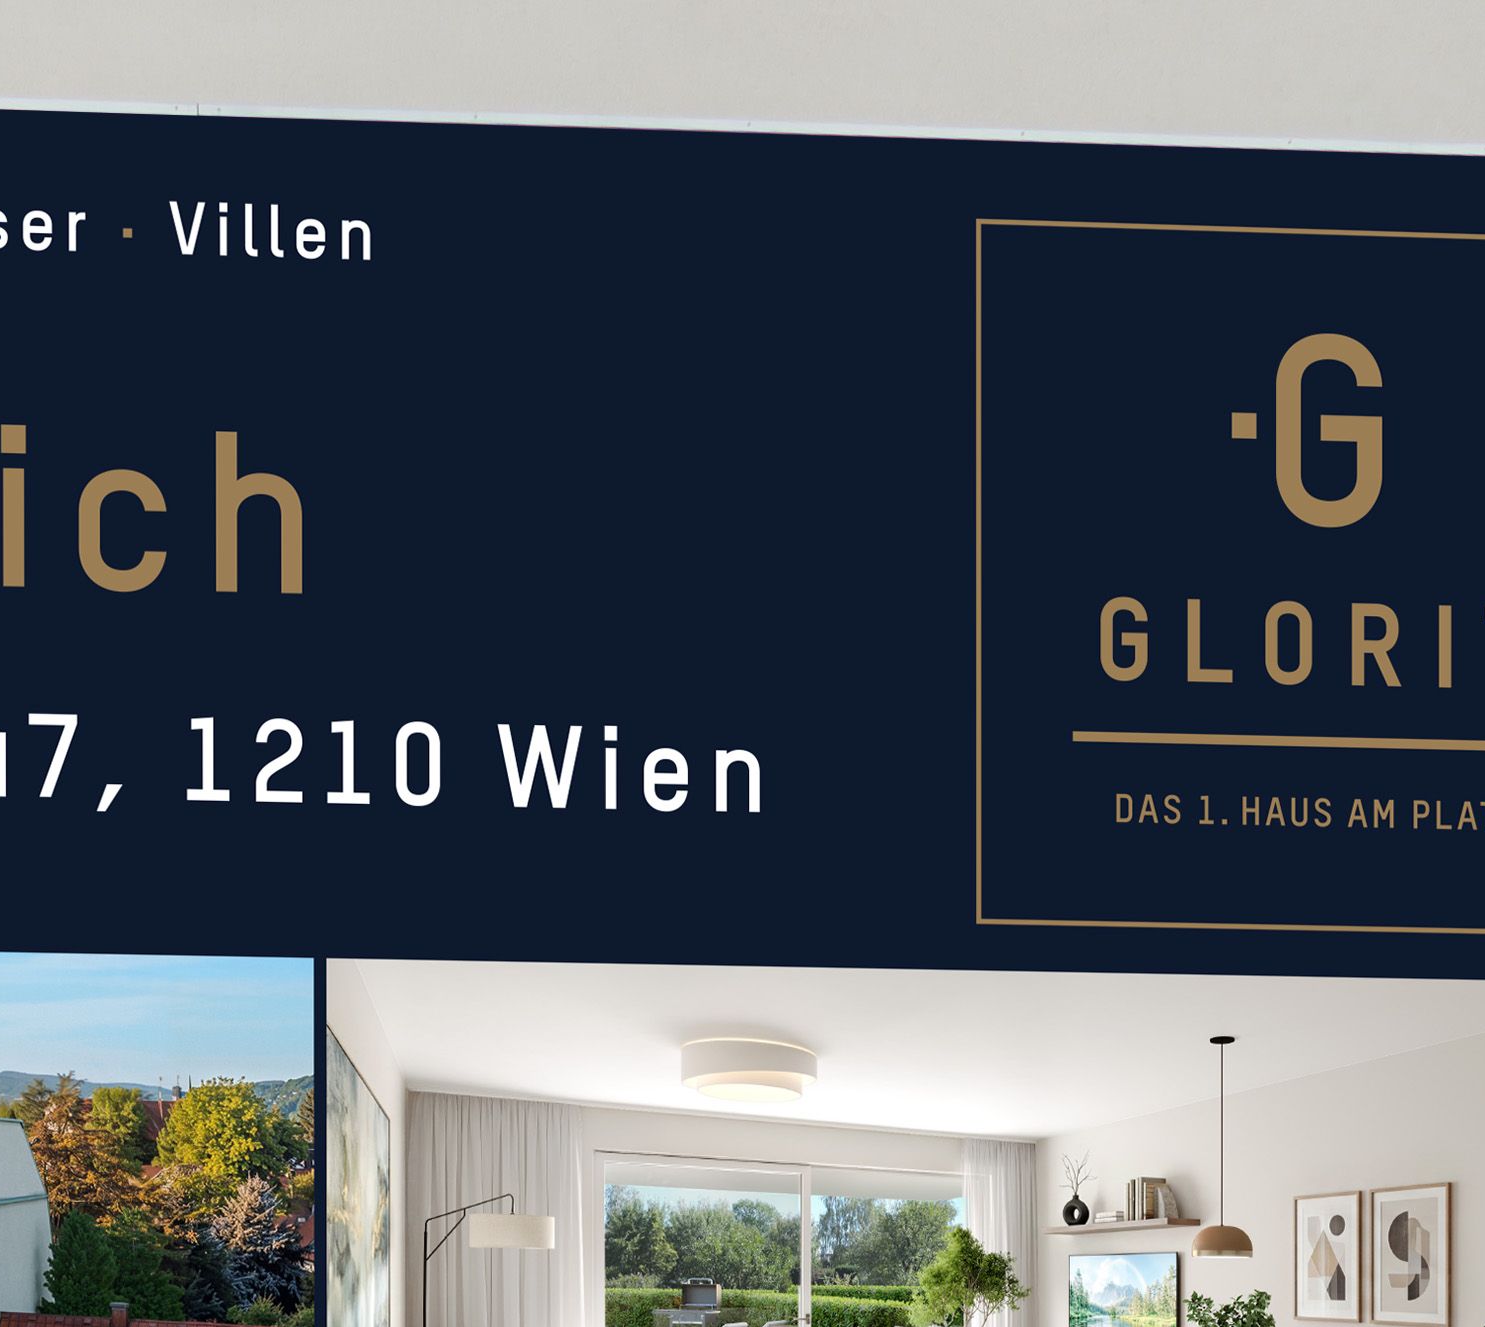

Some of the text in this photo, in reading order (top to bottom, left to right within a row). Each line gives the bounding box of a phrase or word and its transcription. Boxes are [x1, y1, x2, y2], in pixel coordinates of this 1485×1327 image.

[169, 200, 371, 261] Villen
[186, 716, 441, 807] 1210
[497, 723, 761, 813] Wien
[1116, 794, 1181, 824] DAS
[1199, 795, 1227, 825] 1.
[1242, 796, 1331, 827] HAUS
[1348, 799, 1394, 828] AM
